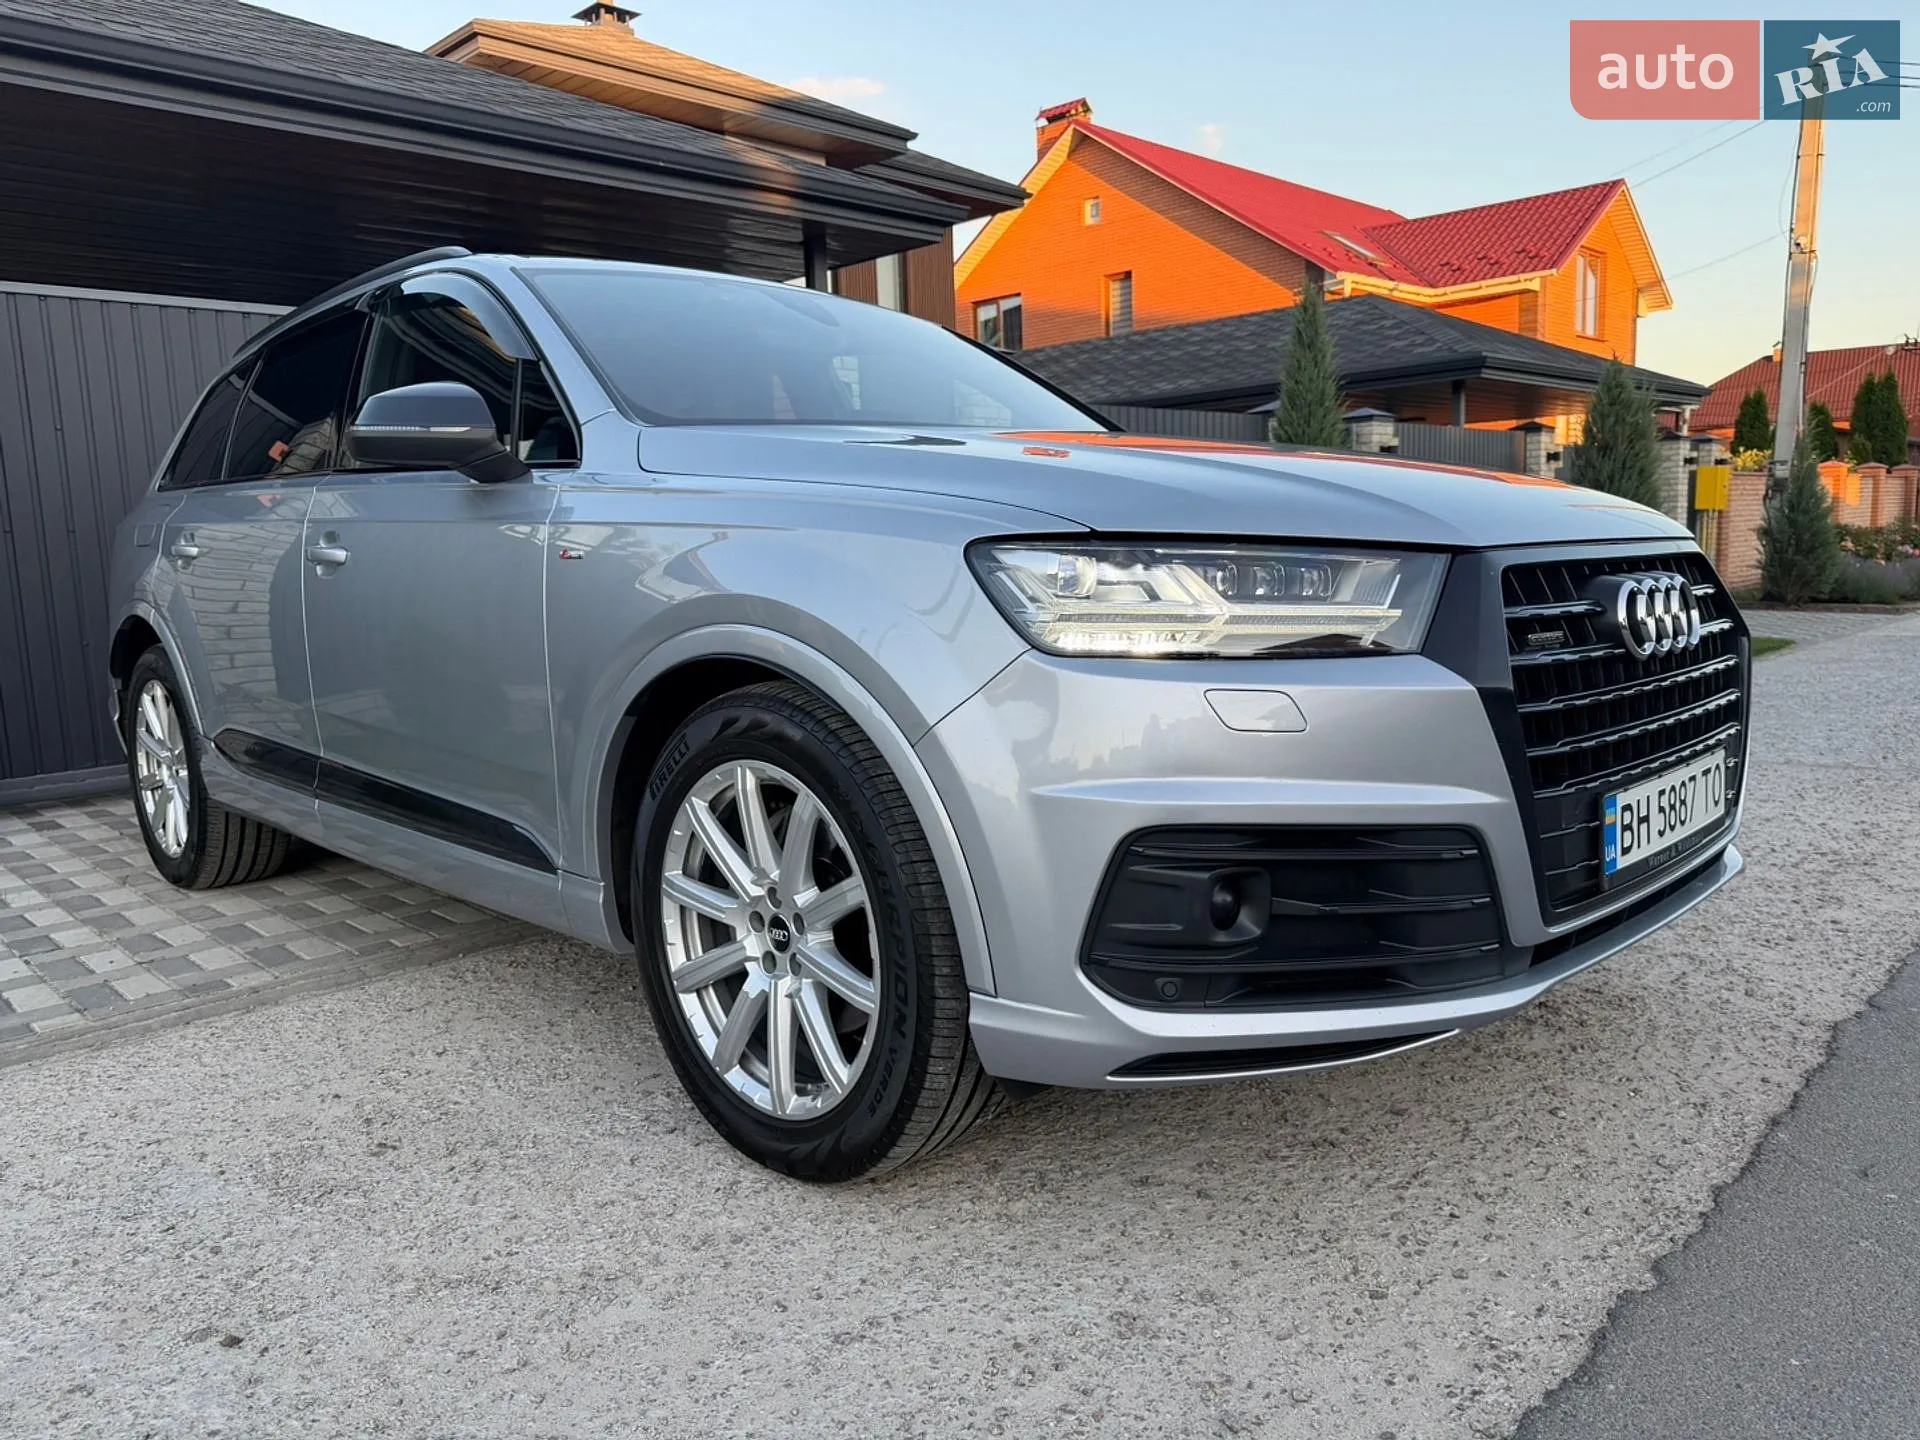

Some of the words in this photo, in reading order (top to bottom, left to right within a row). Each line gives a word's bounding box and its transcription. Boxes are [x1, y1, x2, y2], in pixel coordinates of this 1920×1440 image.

[650, 732, 690, 800] PIRELLI
[1621, 795, 1650, 857] BH
[1658, 774, 1697, 838] 5887
[1701, 762, 1722, 813] TO
[1605, 844, 1616, 862] UA
